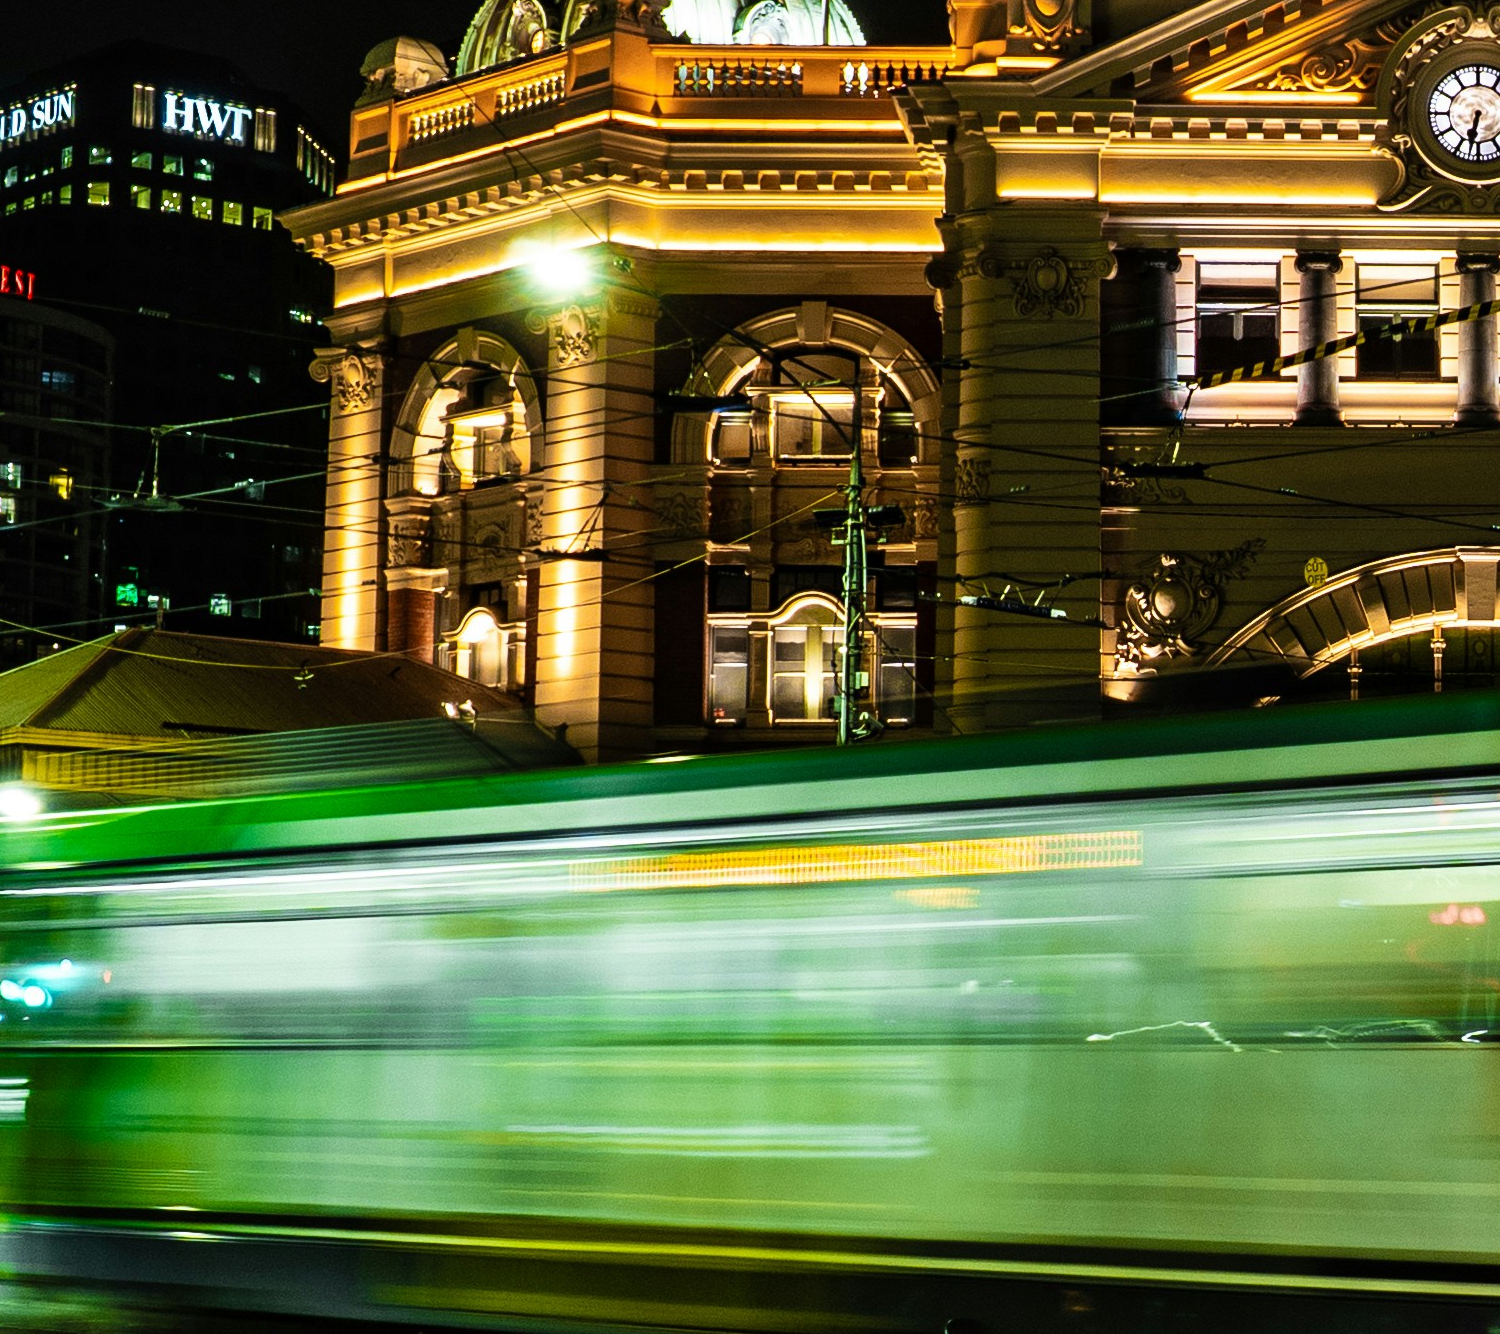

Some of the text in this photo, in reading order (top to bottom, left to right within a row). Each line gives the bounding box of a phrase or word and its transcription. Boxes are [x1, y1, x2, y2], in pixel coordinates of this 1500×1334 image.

[32, 90, 74, 130] SUN
[164, 93, 253, 142] HWT
[1305, 561, 1324, 572] CUT
[1307, 573, 1325, 584] OFF
